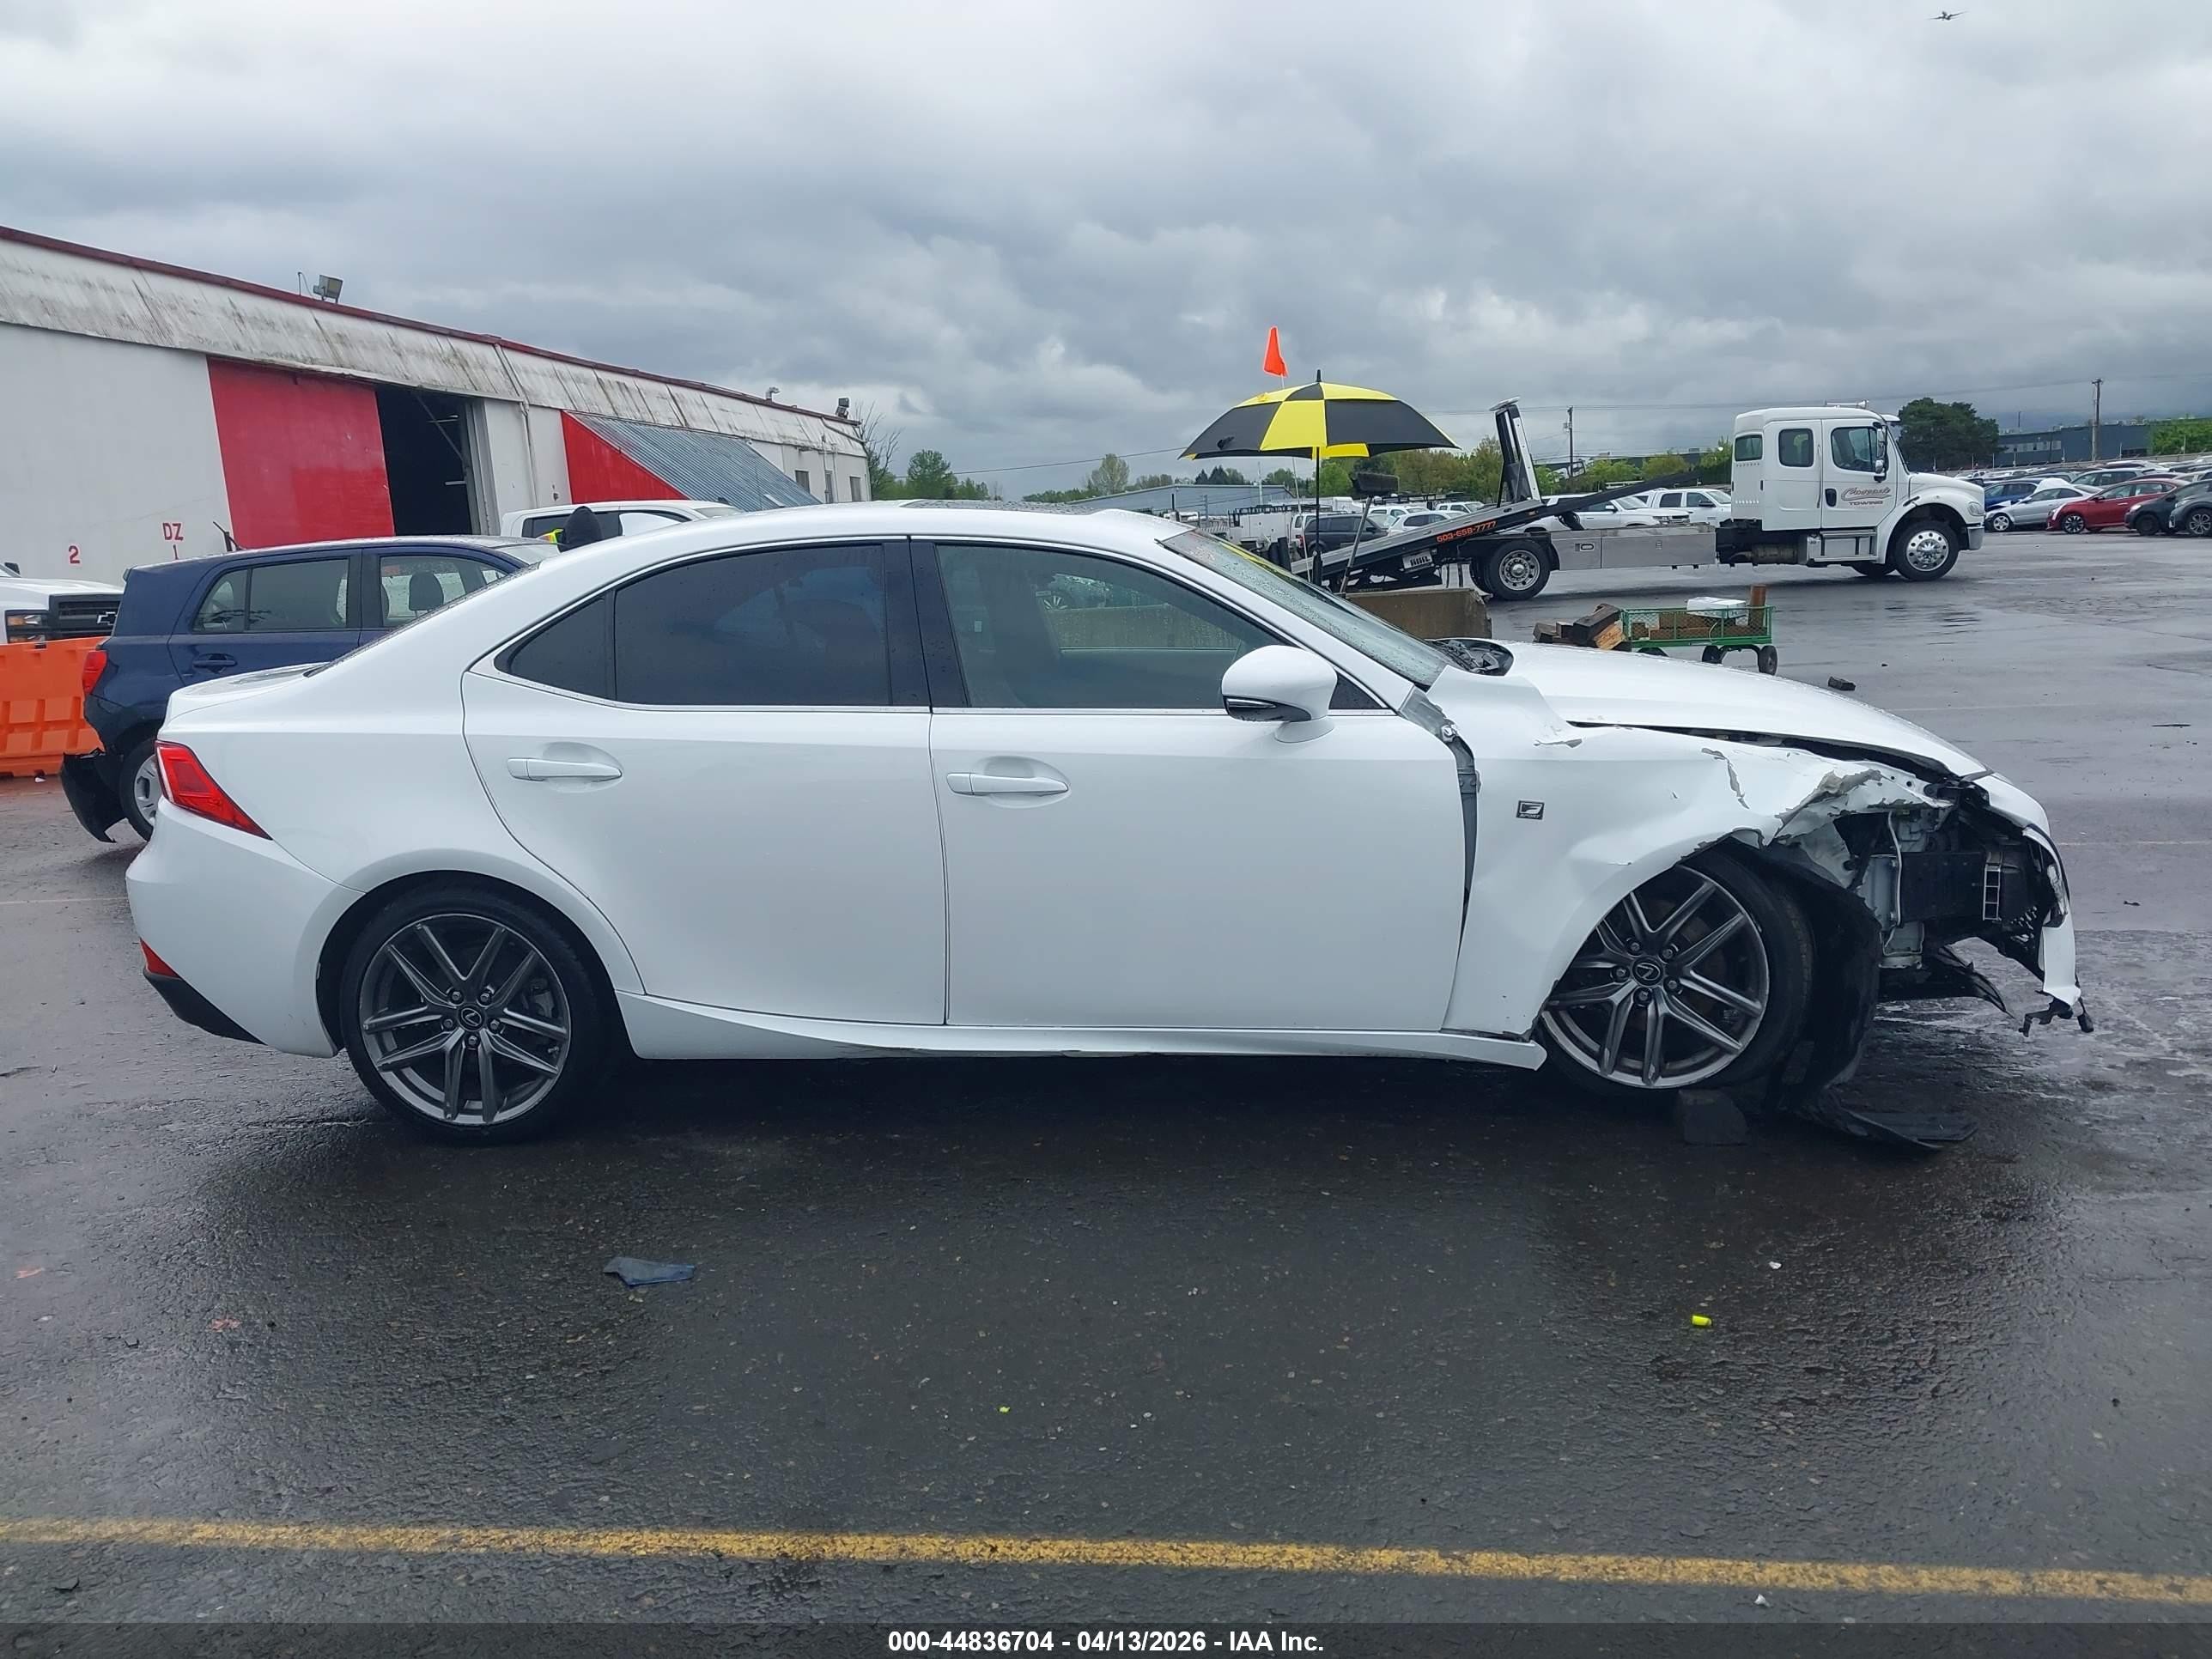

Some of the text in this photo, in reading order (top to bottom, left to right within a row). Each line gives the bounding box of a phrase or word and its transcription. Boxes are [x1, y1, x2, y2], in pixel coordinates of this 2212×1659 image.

[162, 522, 184, 541] DZ
[1437, 521, 1497, 543] 503-658-7777
[68, 545, 81, 564] 2
